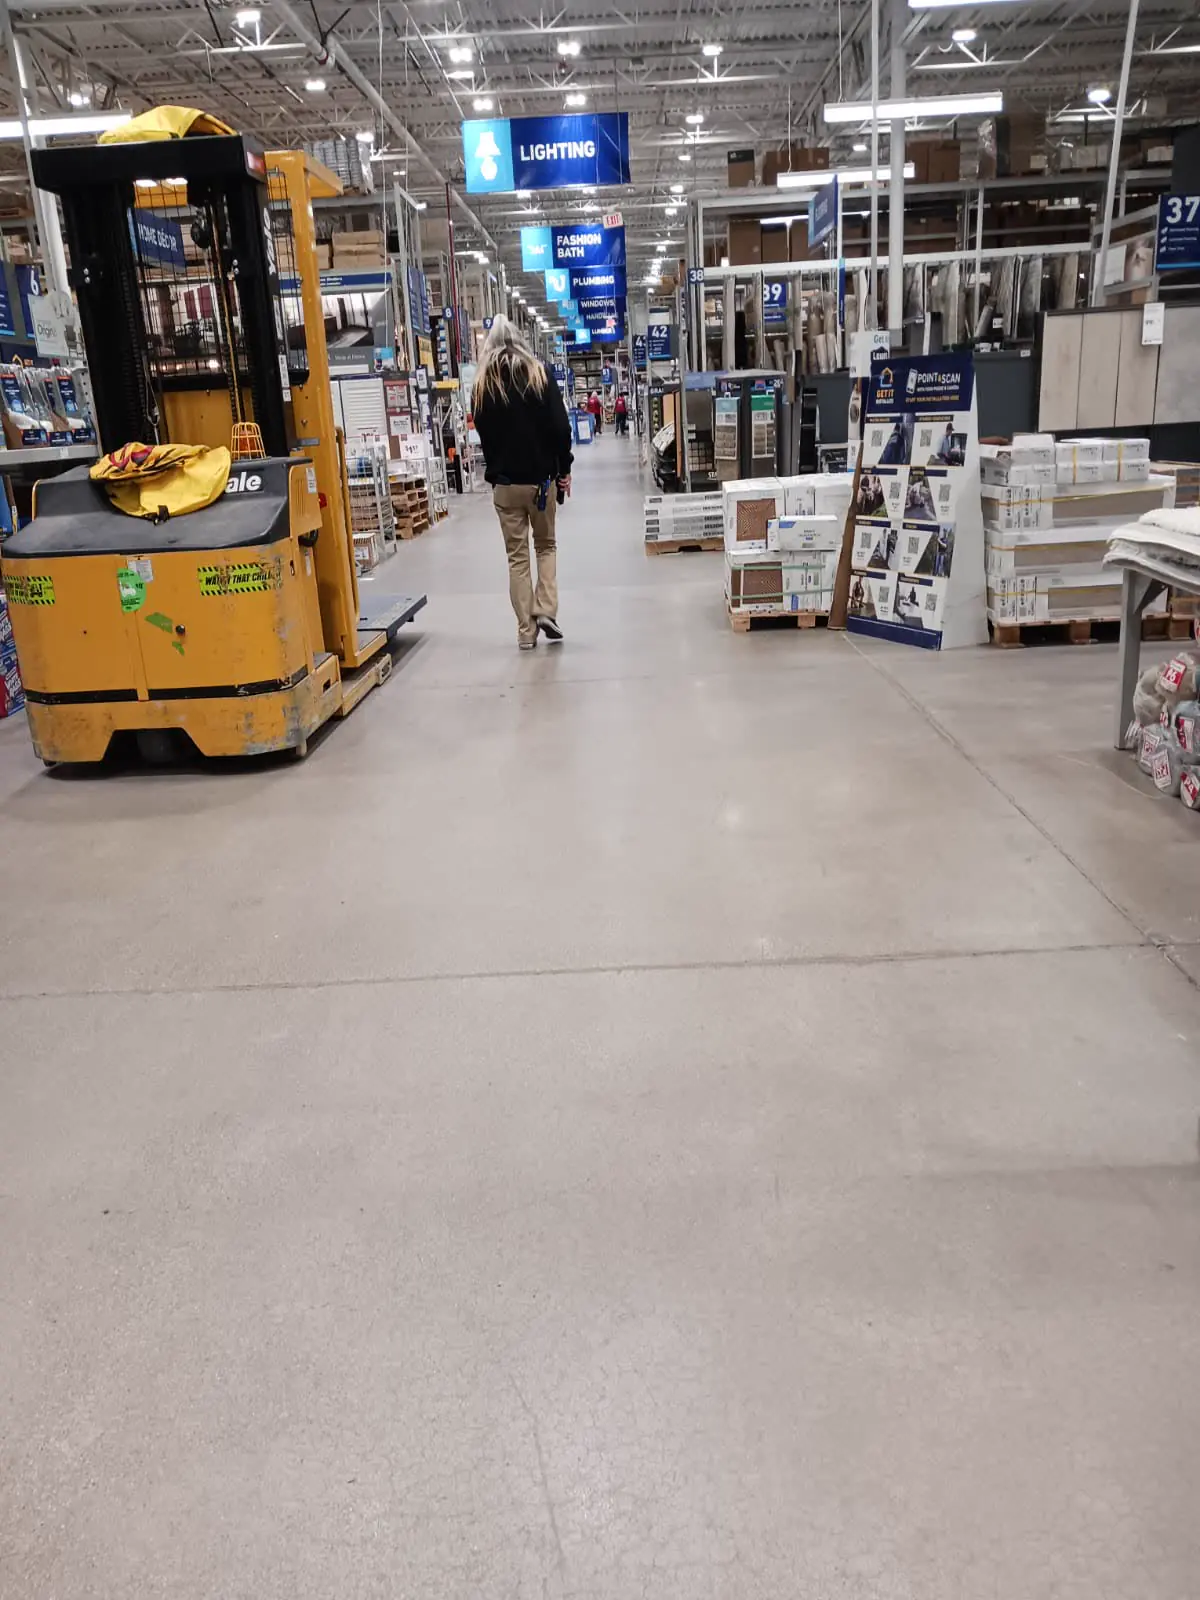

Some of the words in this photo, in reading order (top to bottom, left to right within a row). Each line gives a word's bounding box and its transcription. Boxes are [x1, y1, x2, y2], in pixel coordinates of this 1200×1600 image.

[520, 141, 596, 162] LIGHTING
[1166, 196, 1200, 224] 37
[606, 214, 620, 226] EXIT
[556, 233, 602, 246] FASHION
[557, 246, 585, 259] BATH
[572, 275, 615, 287] PLUMBING
[690, 270, 704, 282] 38
[30, 270, 40, 296] 6
[580, 299, 614, 308] WINDOWS
[445, 309, 452, 317] 8
[485, 319, 491, 328] 9
[651, 325, 668, 338] 42
[873, 334, 884, 344] Get
[917, 372, 938, 383] POINT
[942, 372, 960, 384] SCAN
[876, 389, 888, 398] GET
[888, 388, 894, 398] IT
[225, 471, 262, 494] ale
[232, 573, 250, 585] THAT
